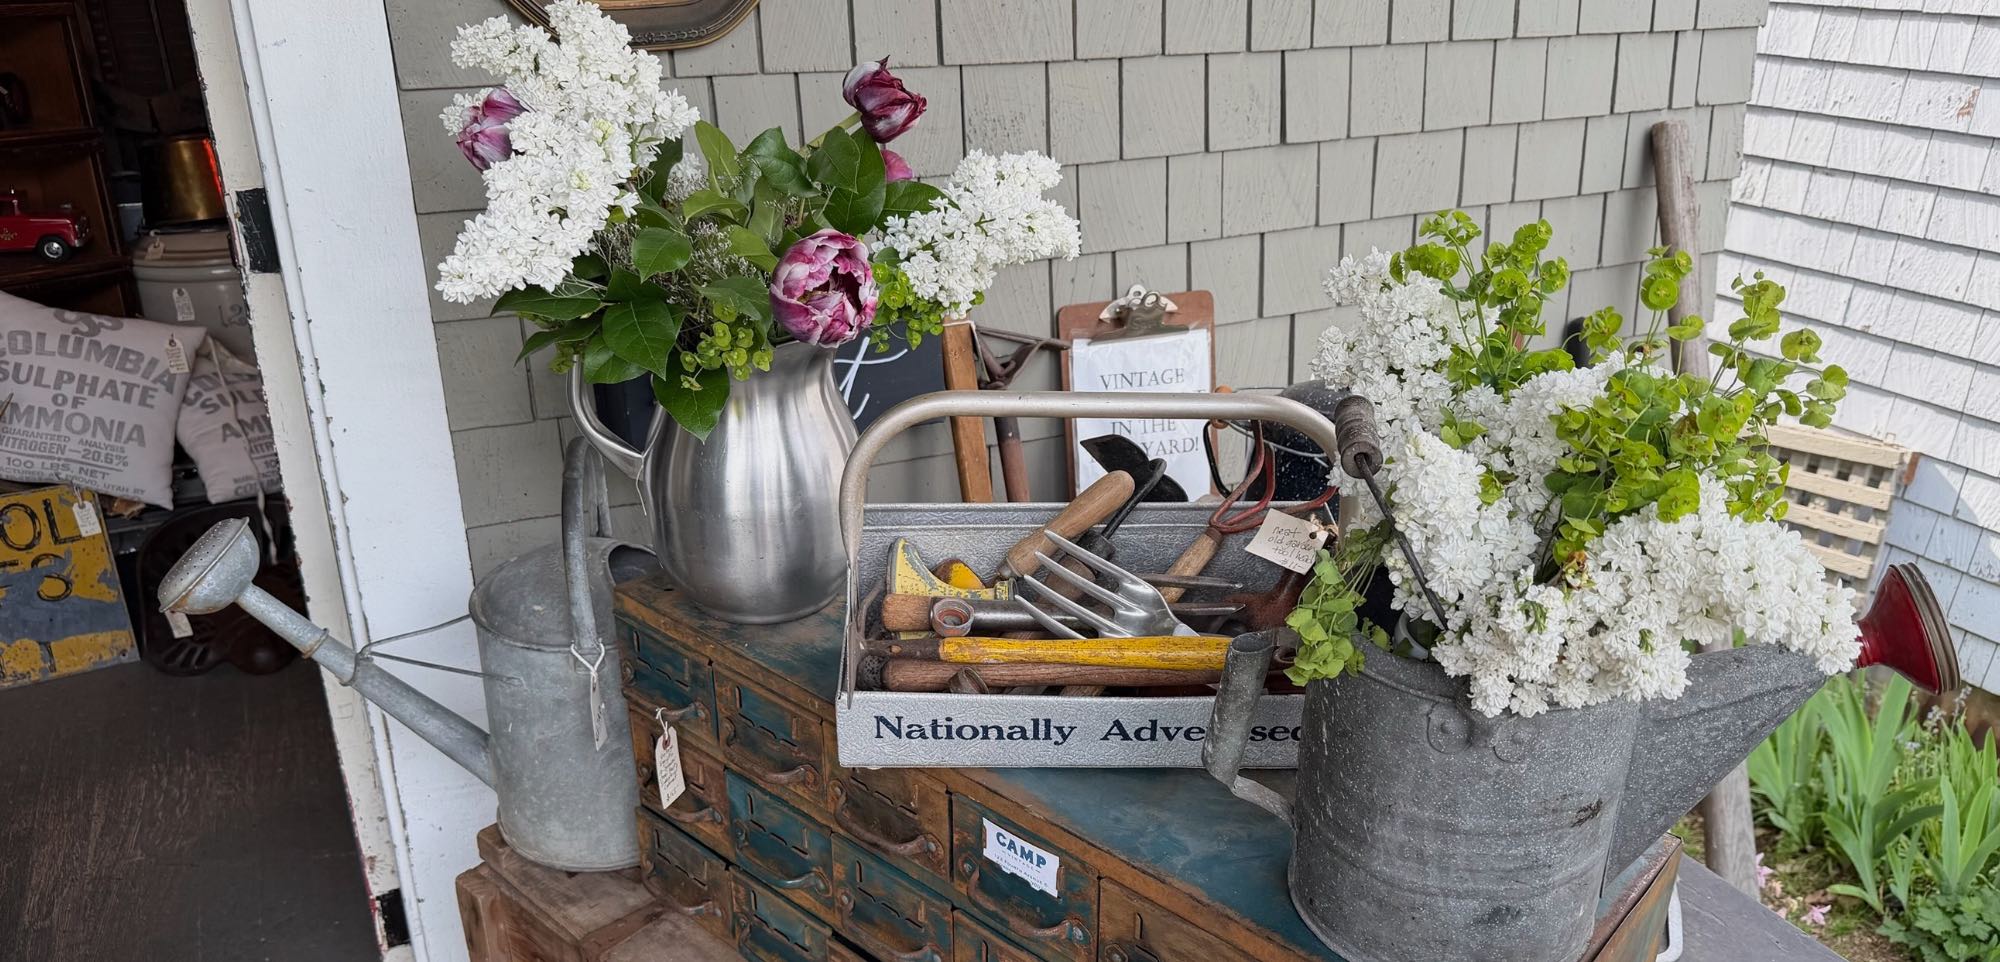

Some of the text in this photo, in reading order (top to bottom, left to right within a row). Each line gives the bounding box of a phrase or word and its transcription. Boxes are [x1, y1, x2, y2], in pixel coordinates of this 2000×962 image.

[0, 359, 159, 409] SULPHATE
[1099, 367, 1185, 390] VINTAGE
[51, 393, 87, 409] OF
[1111, 419, 1177, 436] IN THE
[1, 426, 126, 454] GUARANTEED ANALYSIS
[1140, 436, 1199, 458] YARD!
[6, 457, 110, 480] 100 LBS. NET
[103, 482, 129, 494] UTAH
[1267, 535, 1285, 545] old
[1272, 545, 1296, 558] tool
[874, 715, 1300, 746] Nationally Advese
[996, 832, 1046, 869] CAMP
